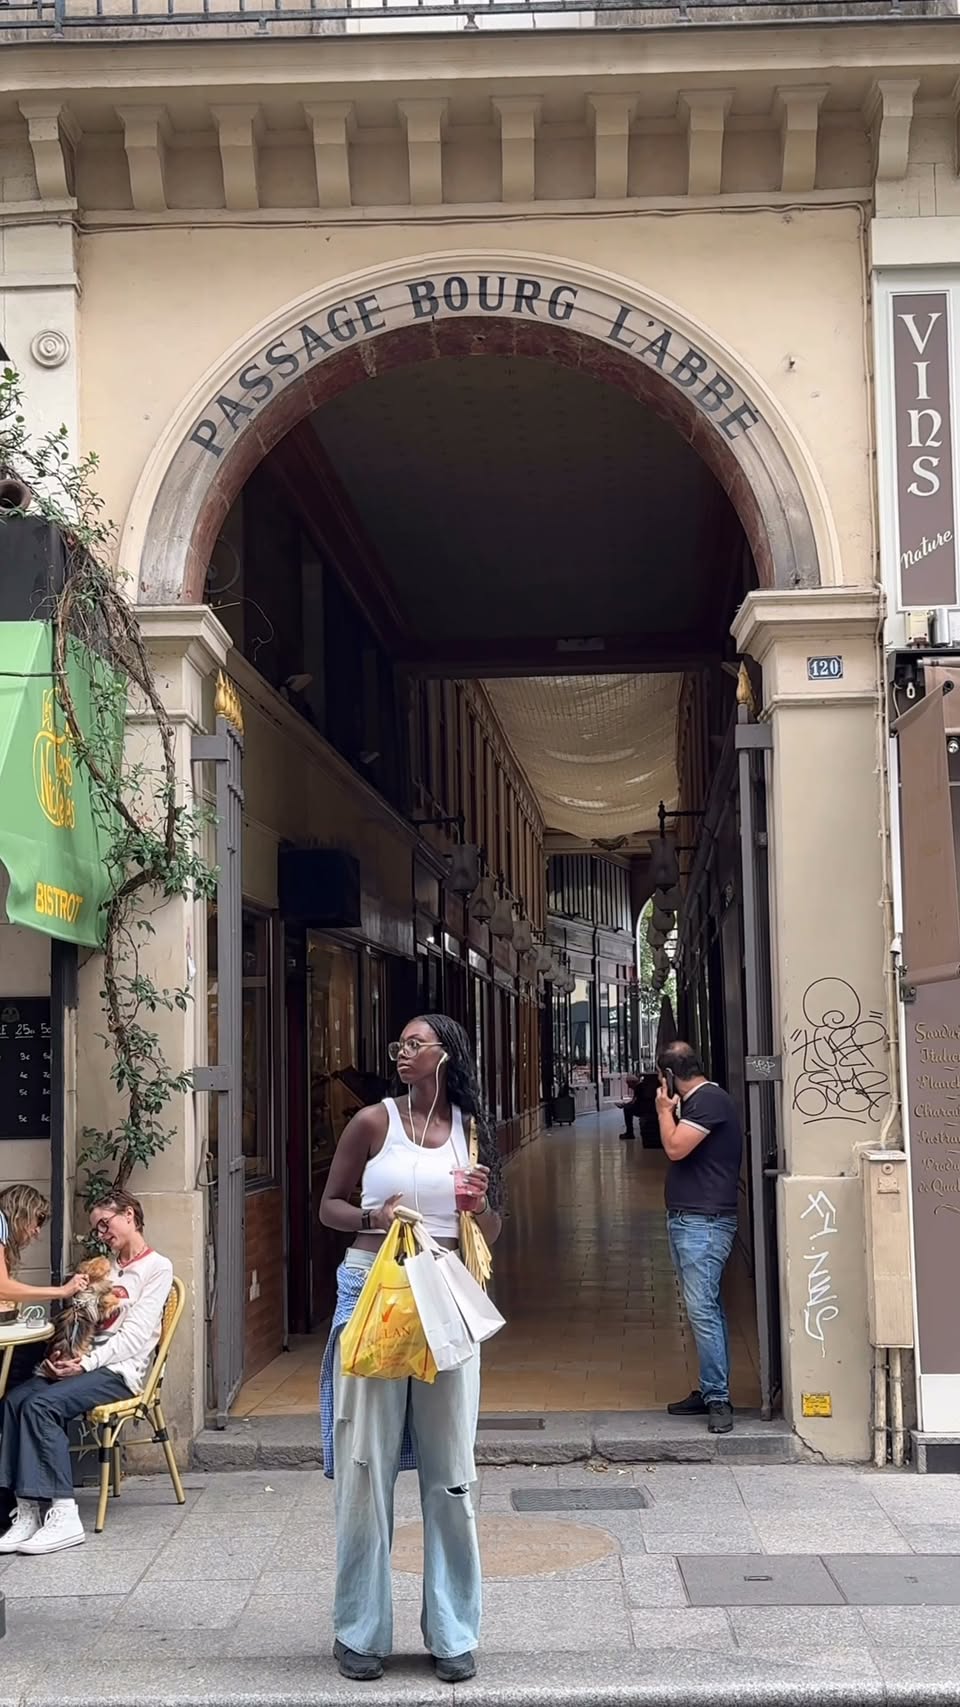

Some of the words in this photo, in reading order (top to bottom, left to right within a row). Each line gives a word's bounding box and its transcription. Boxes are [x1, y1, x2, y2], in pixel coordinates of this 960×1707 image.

[190, 294, 386, 458] PASSAGE
[406, 275, 579, 321] BOURG
[811, 659, 839, 676] 120
[35, 881, 84, 924] BISTROT
